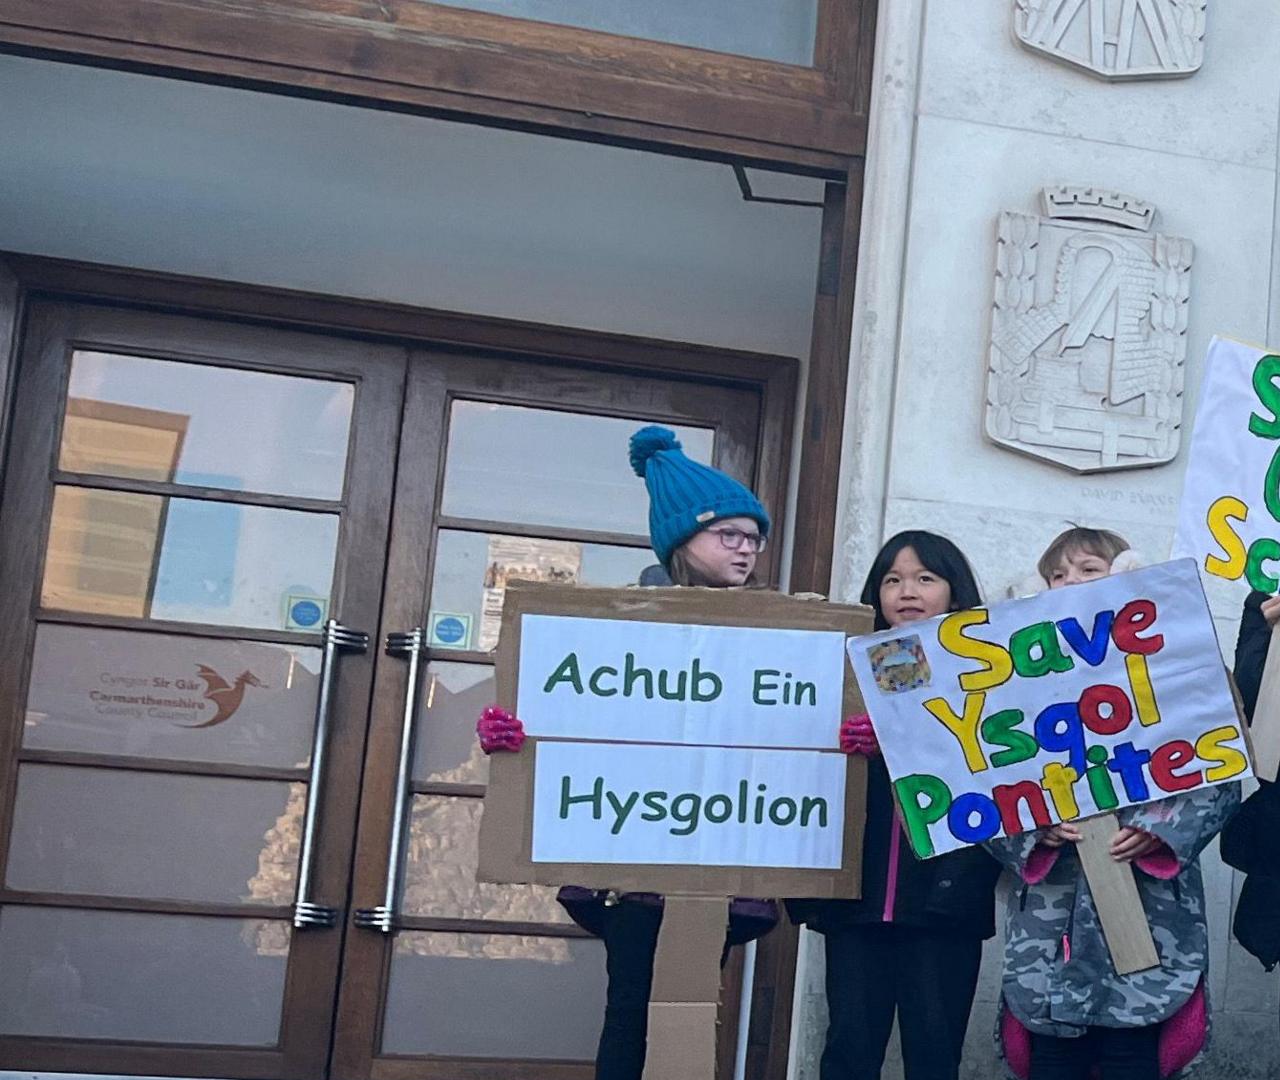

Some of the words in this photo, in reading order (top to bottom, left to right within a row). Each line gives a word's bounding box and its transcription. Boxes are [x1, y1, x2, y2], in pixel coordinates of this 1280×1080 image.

[938, 599, 1164, 691] Save
[89, 690, 205, 709] Carmarthenshire
[152, 677, 170, 688] Sir
[543, 652, 722, 702] Achub
[752, 669, 817, 706] Ein
[923, 653, 1161, 776] Ysgol
[559, 775, 828, 836] Hysgolion
[894, 726, 1248, 859] Pontites
